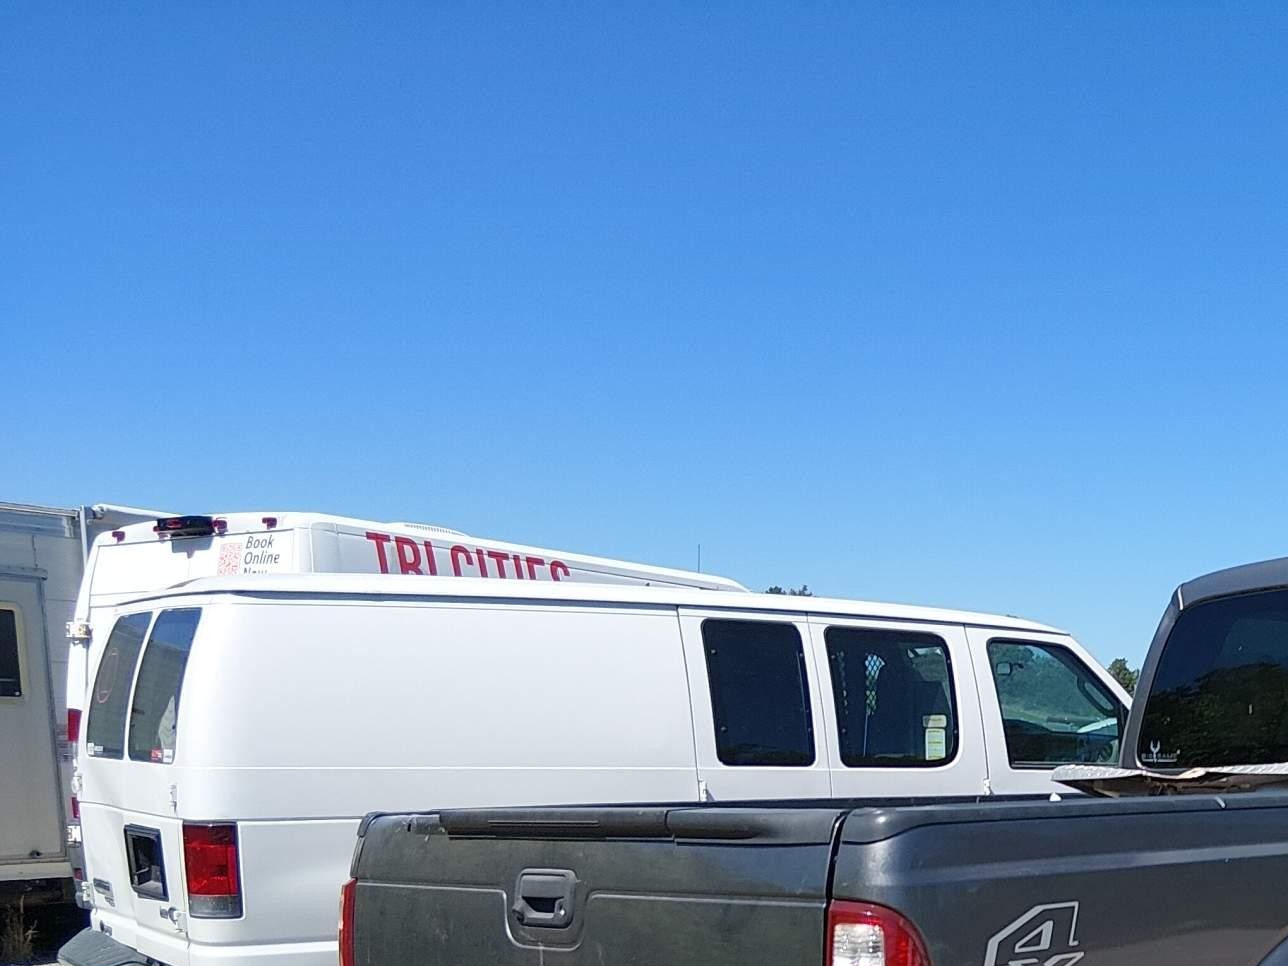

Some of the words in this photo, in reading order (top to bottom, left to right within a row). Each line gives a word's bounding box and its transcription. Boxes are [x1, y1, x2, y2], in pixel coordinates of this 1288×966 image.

[245, 534, 275, 549] Book
[244, 550, 280, 565] Online
[366, 531, 438, 576] TRI
